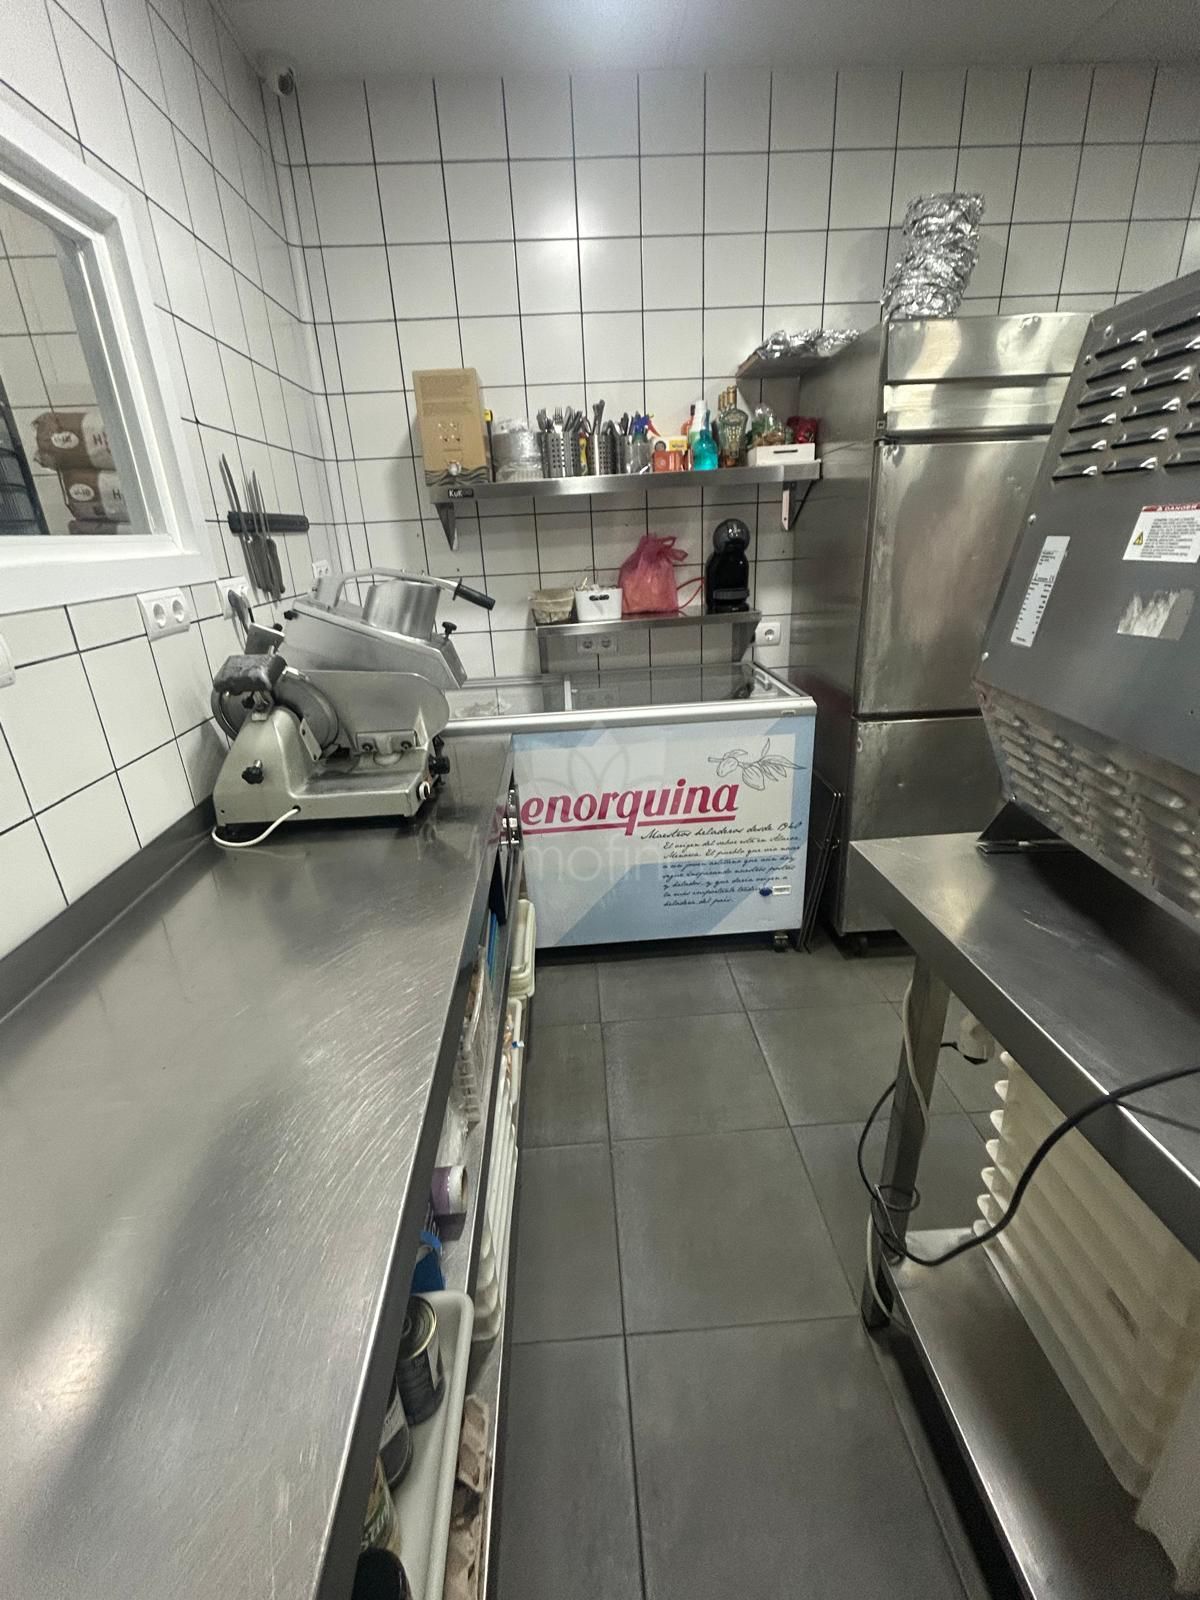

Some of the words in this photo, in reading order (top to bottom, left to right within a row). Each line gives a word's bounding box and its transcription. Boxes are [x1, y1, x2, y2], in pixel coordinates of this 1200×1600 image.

[521, 778, 740, 837] enorquina
[641, 828, 692, 840] Maestros
[694, 826, 744, 836] heladeros
[746, 823, 774, 833] desde
